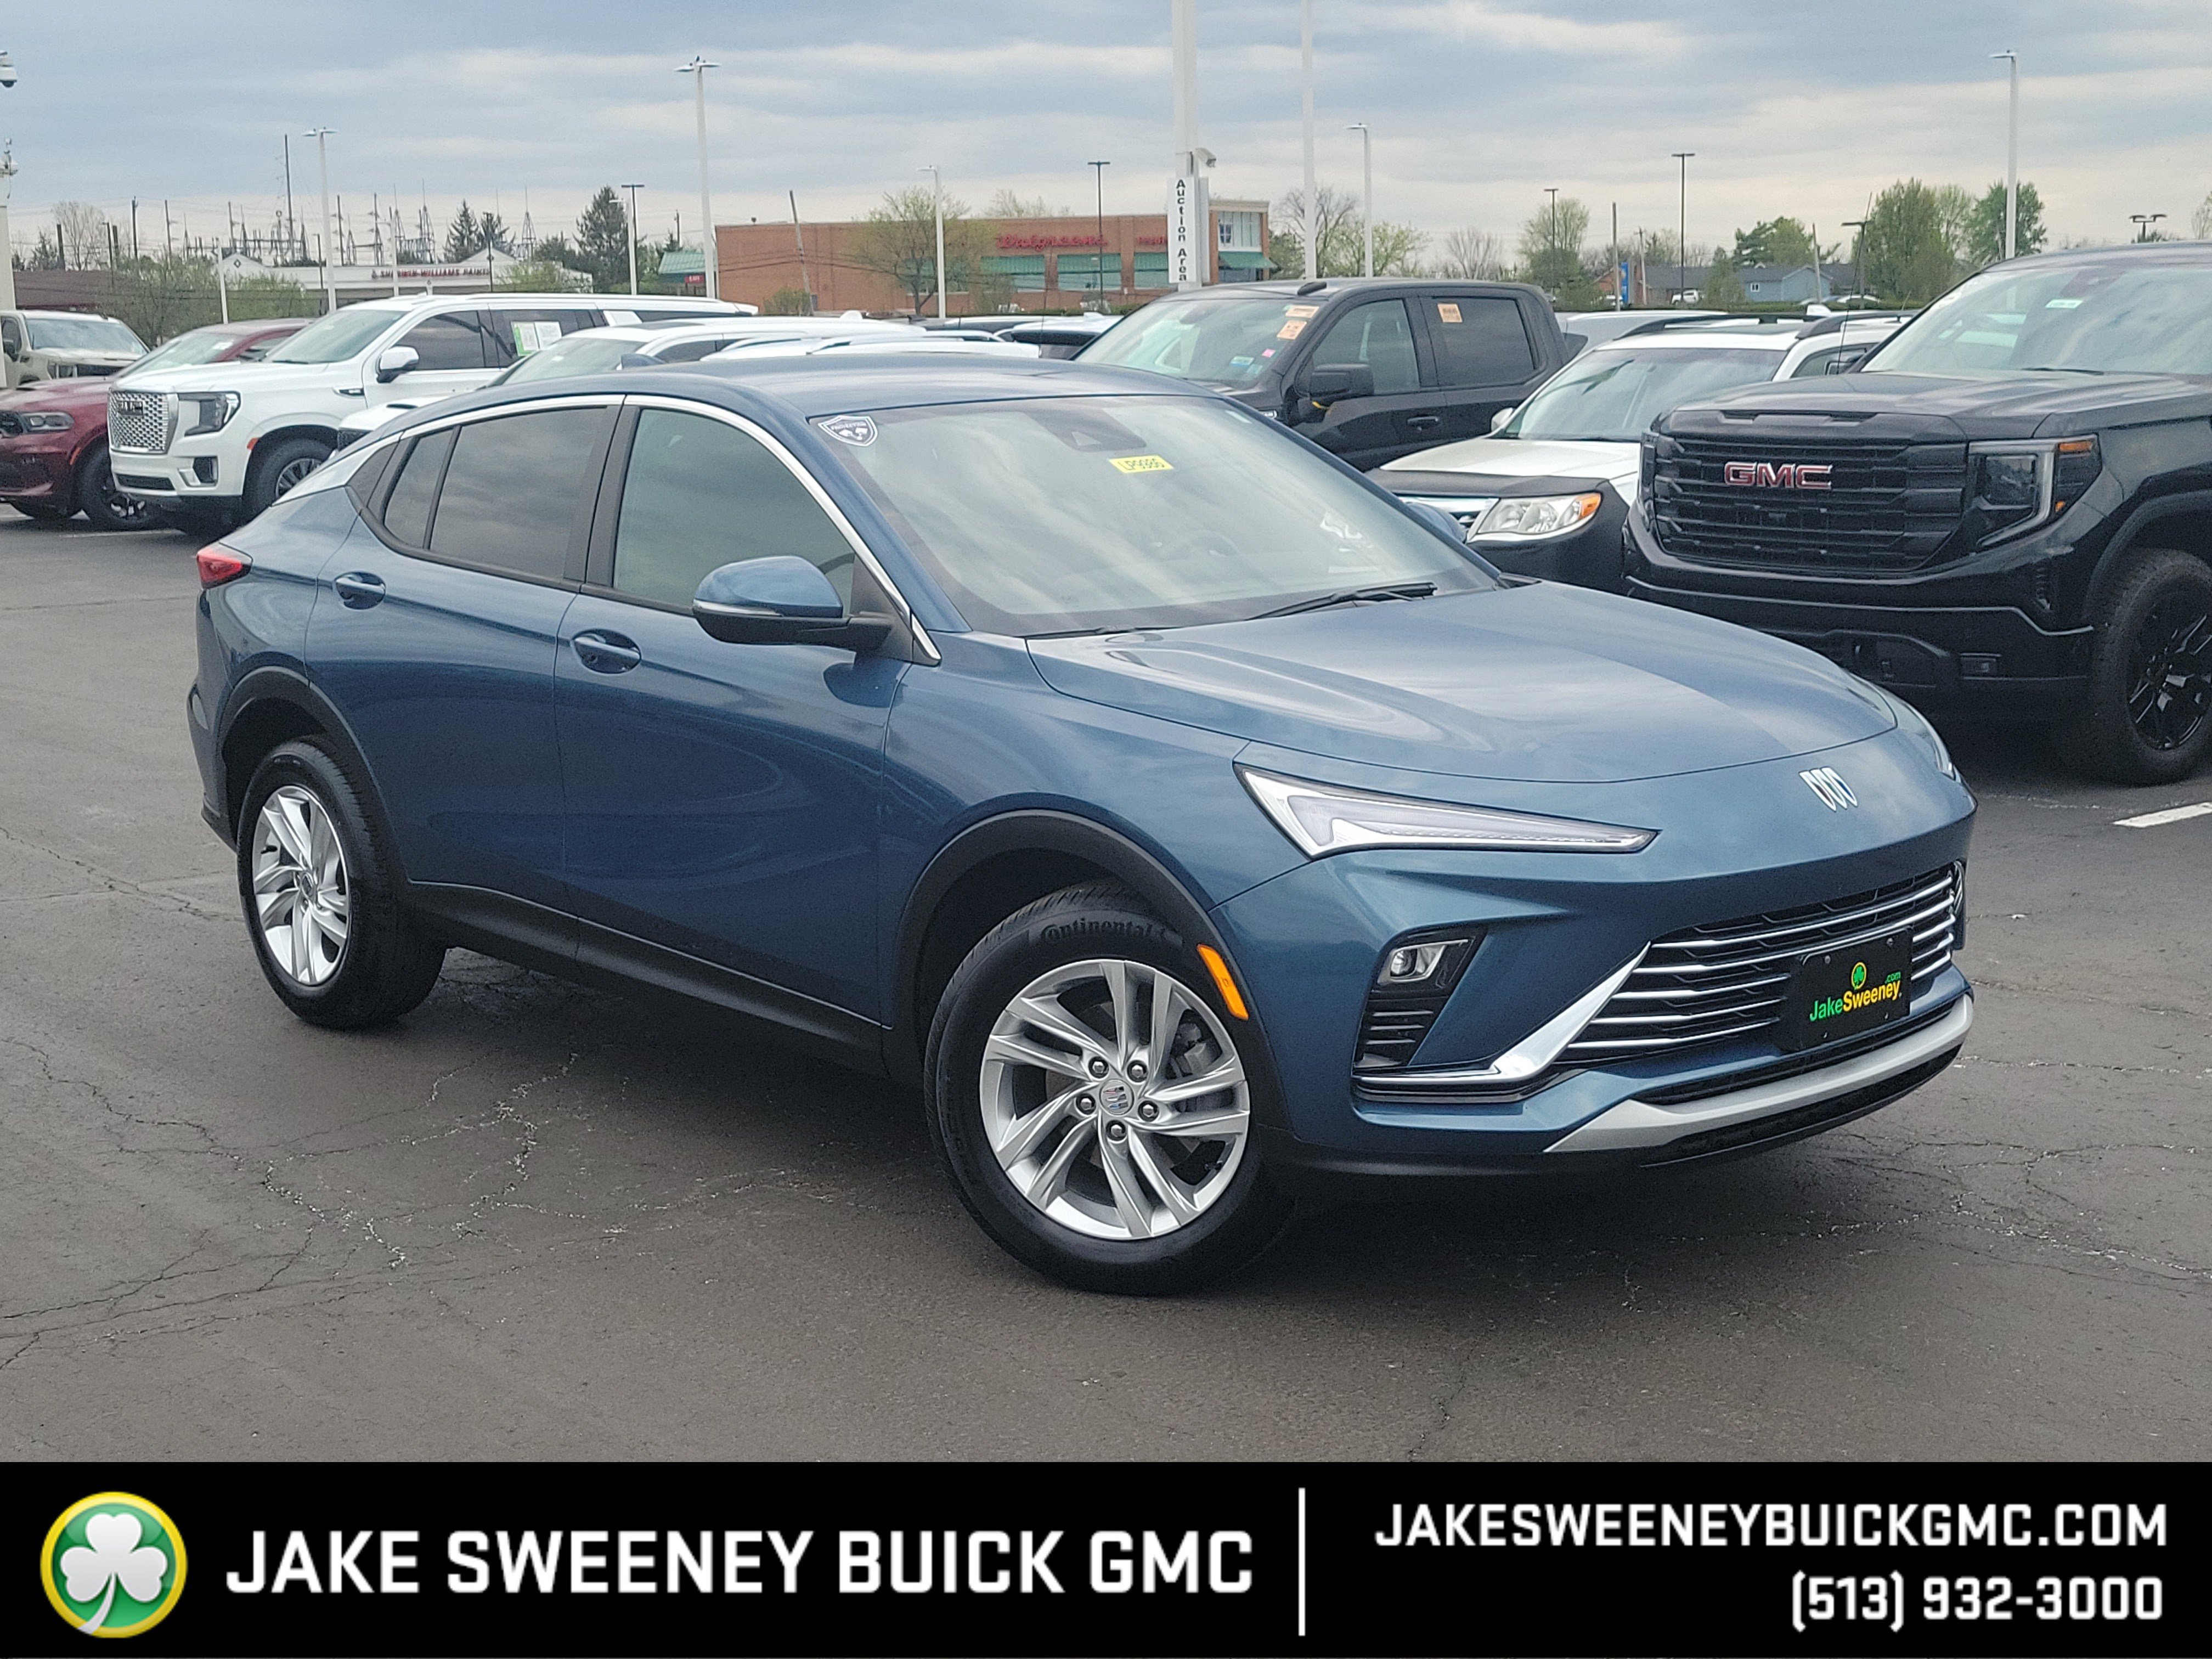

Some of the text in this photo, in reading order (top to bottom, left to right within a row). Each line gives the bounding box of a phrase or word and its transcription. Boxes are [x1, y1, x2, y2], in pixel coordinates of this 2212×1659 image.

[1176, 179, 1187, 281] Auction Area
[1724, 461, 1833, 490] GMC
